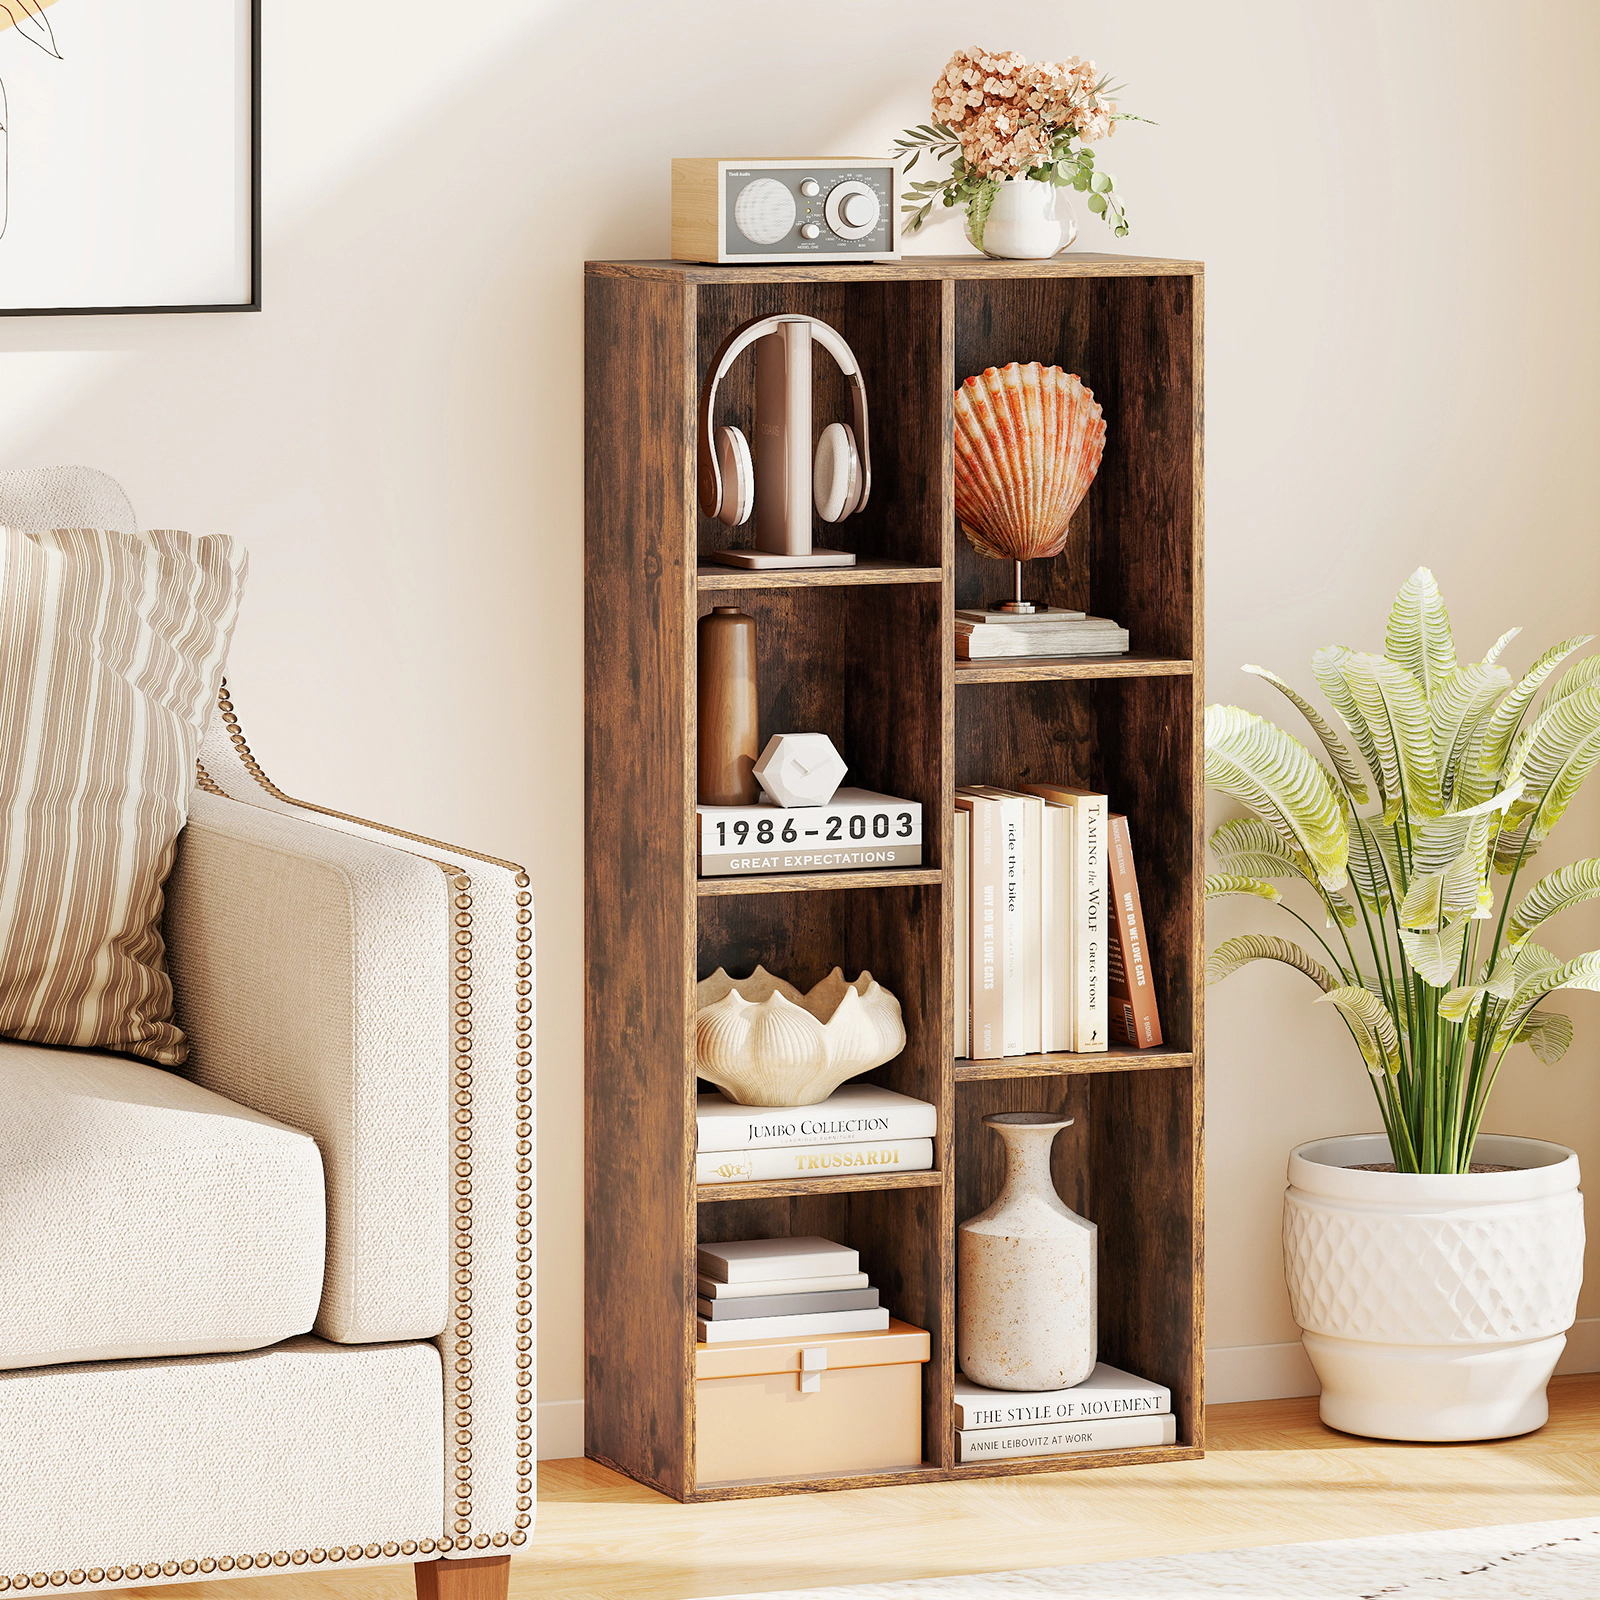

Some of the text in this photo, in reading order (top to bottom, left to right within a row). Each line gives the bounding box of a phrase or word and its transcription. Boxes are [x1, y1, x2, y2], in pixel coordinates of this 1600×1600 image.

[729, 851, 896, 870] GREAT EXPECTATIONS
[1008, 823, 1017, 912] ride the bike
[1088, 804, 1100, 1011] TAMING the WOLF GREG STONE
[984, 885, 994, 990] WHY DO WE LOVE CATS
[1123, 892, 1146, 987] WHY DO WE LOVE CATS
[1144, 1021, 1153, 1043] BOOKS
[747, 1117, 890, 1144] JUMBO COLLECTION
[795, 1149, 900, 1171] TRUSSARDI
[973, 1396, 1162, 1424] THE STYLE OF MOVEMENT
[970, 1432, 1093, 1452] ANNIE LEIBOVITZ AT WORK
